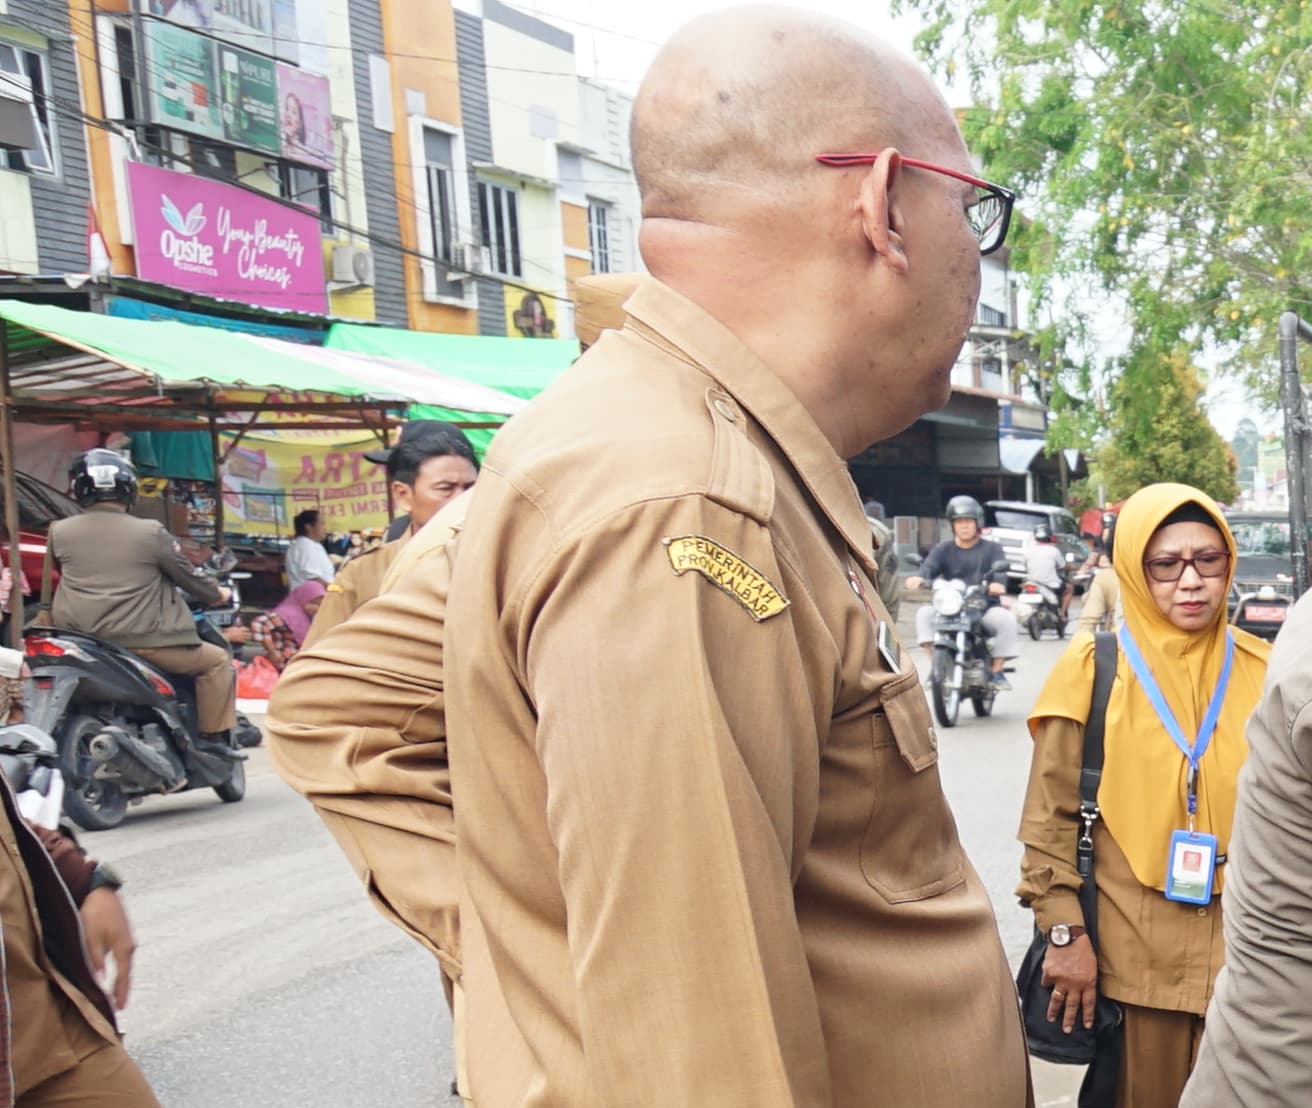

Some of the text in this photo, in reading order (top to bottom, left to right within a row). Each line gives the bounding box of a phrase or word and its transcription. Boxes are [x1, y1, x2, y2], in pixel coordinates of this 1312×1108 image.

[161, 230, 215, 267] Opshe
[254, 218, 304, 267] Beauty
[682, 540, 776, 604] PEMERINTAH
